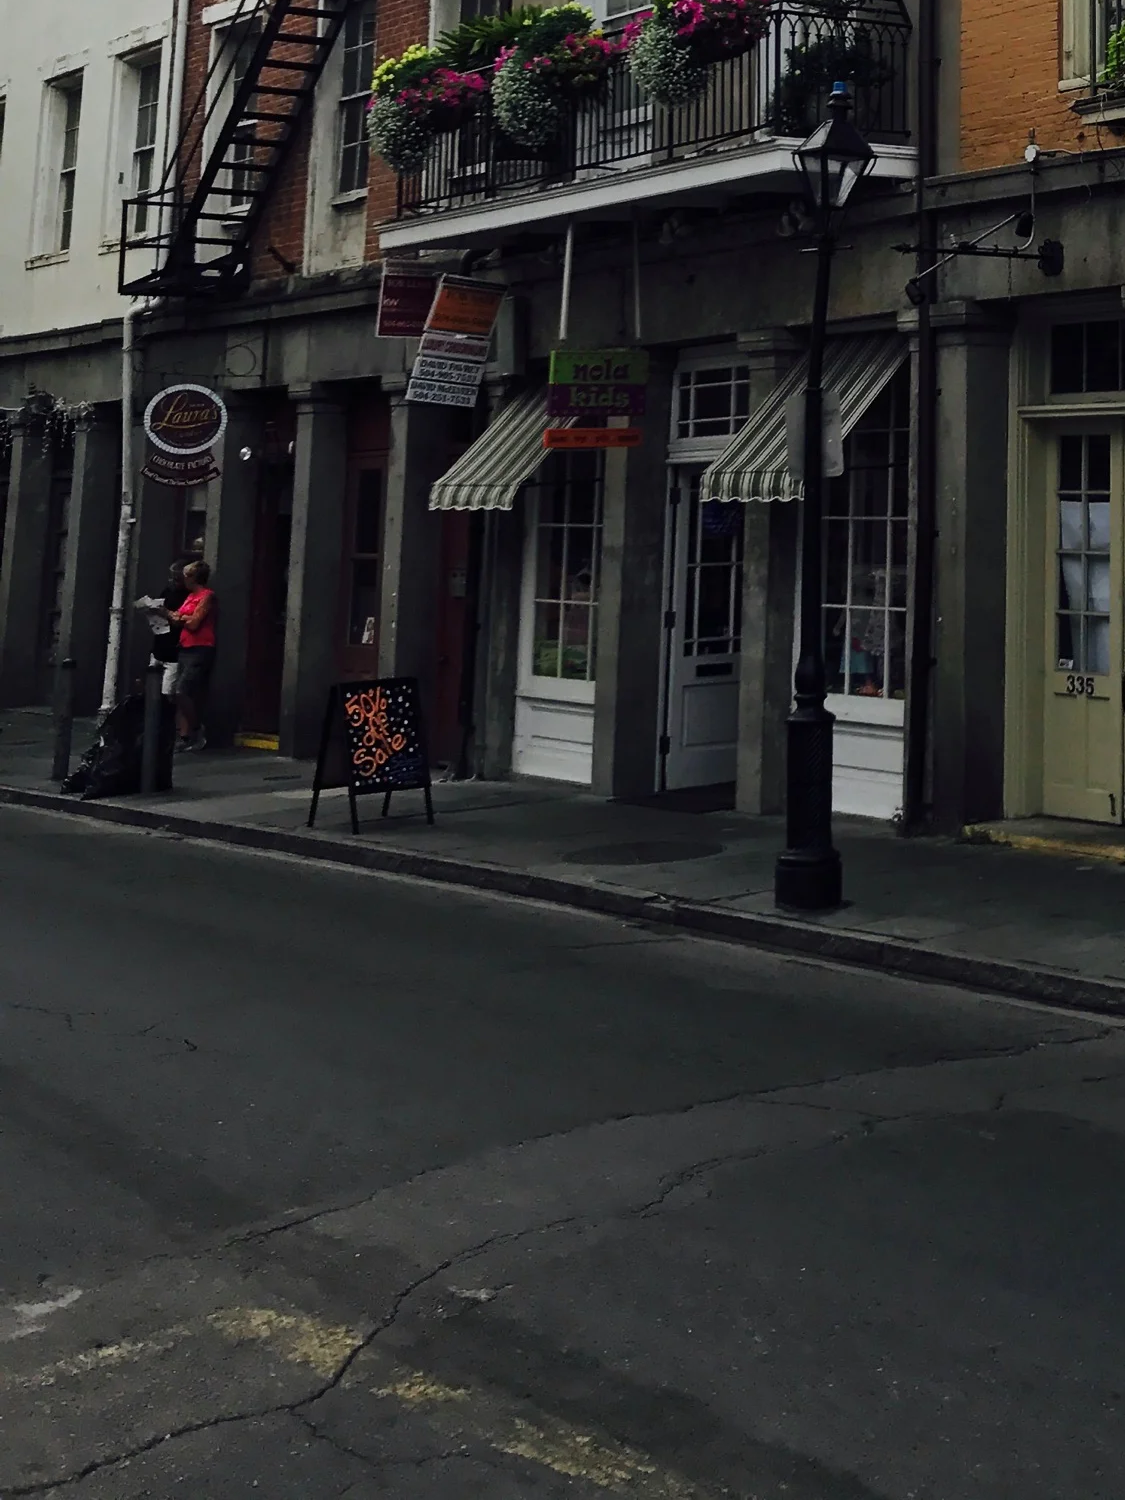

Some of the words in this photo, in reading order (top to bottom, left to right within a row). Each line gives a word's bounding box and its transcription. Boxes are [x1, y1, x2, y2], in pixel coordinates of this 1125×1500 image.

[420, 360, 447, 370] DAVID
[573, 358, 630, 381] nola
[411, 381, 436, 392] DAVID
[568, 386, 630, 408] kids
[151, 393, 220, 431] Laura's
[1066, 674, 1094, 696] 335
[345, 686, 388, 727] 50%
[353, 733, 407, 777] Sale
